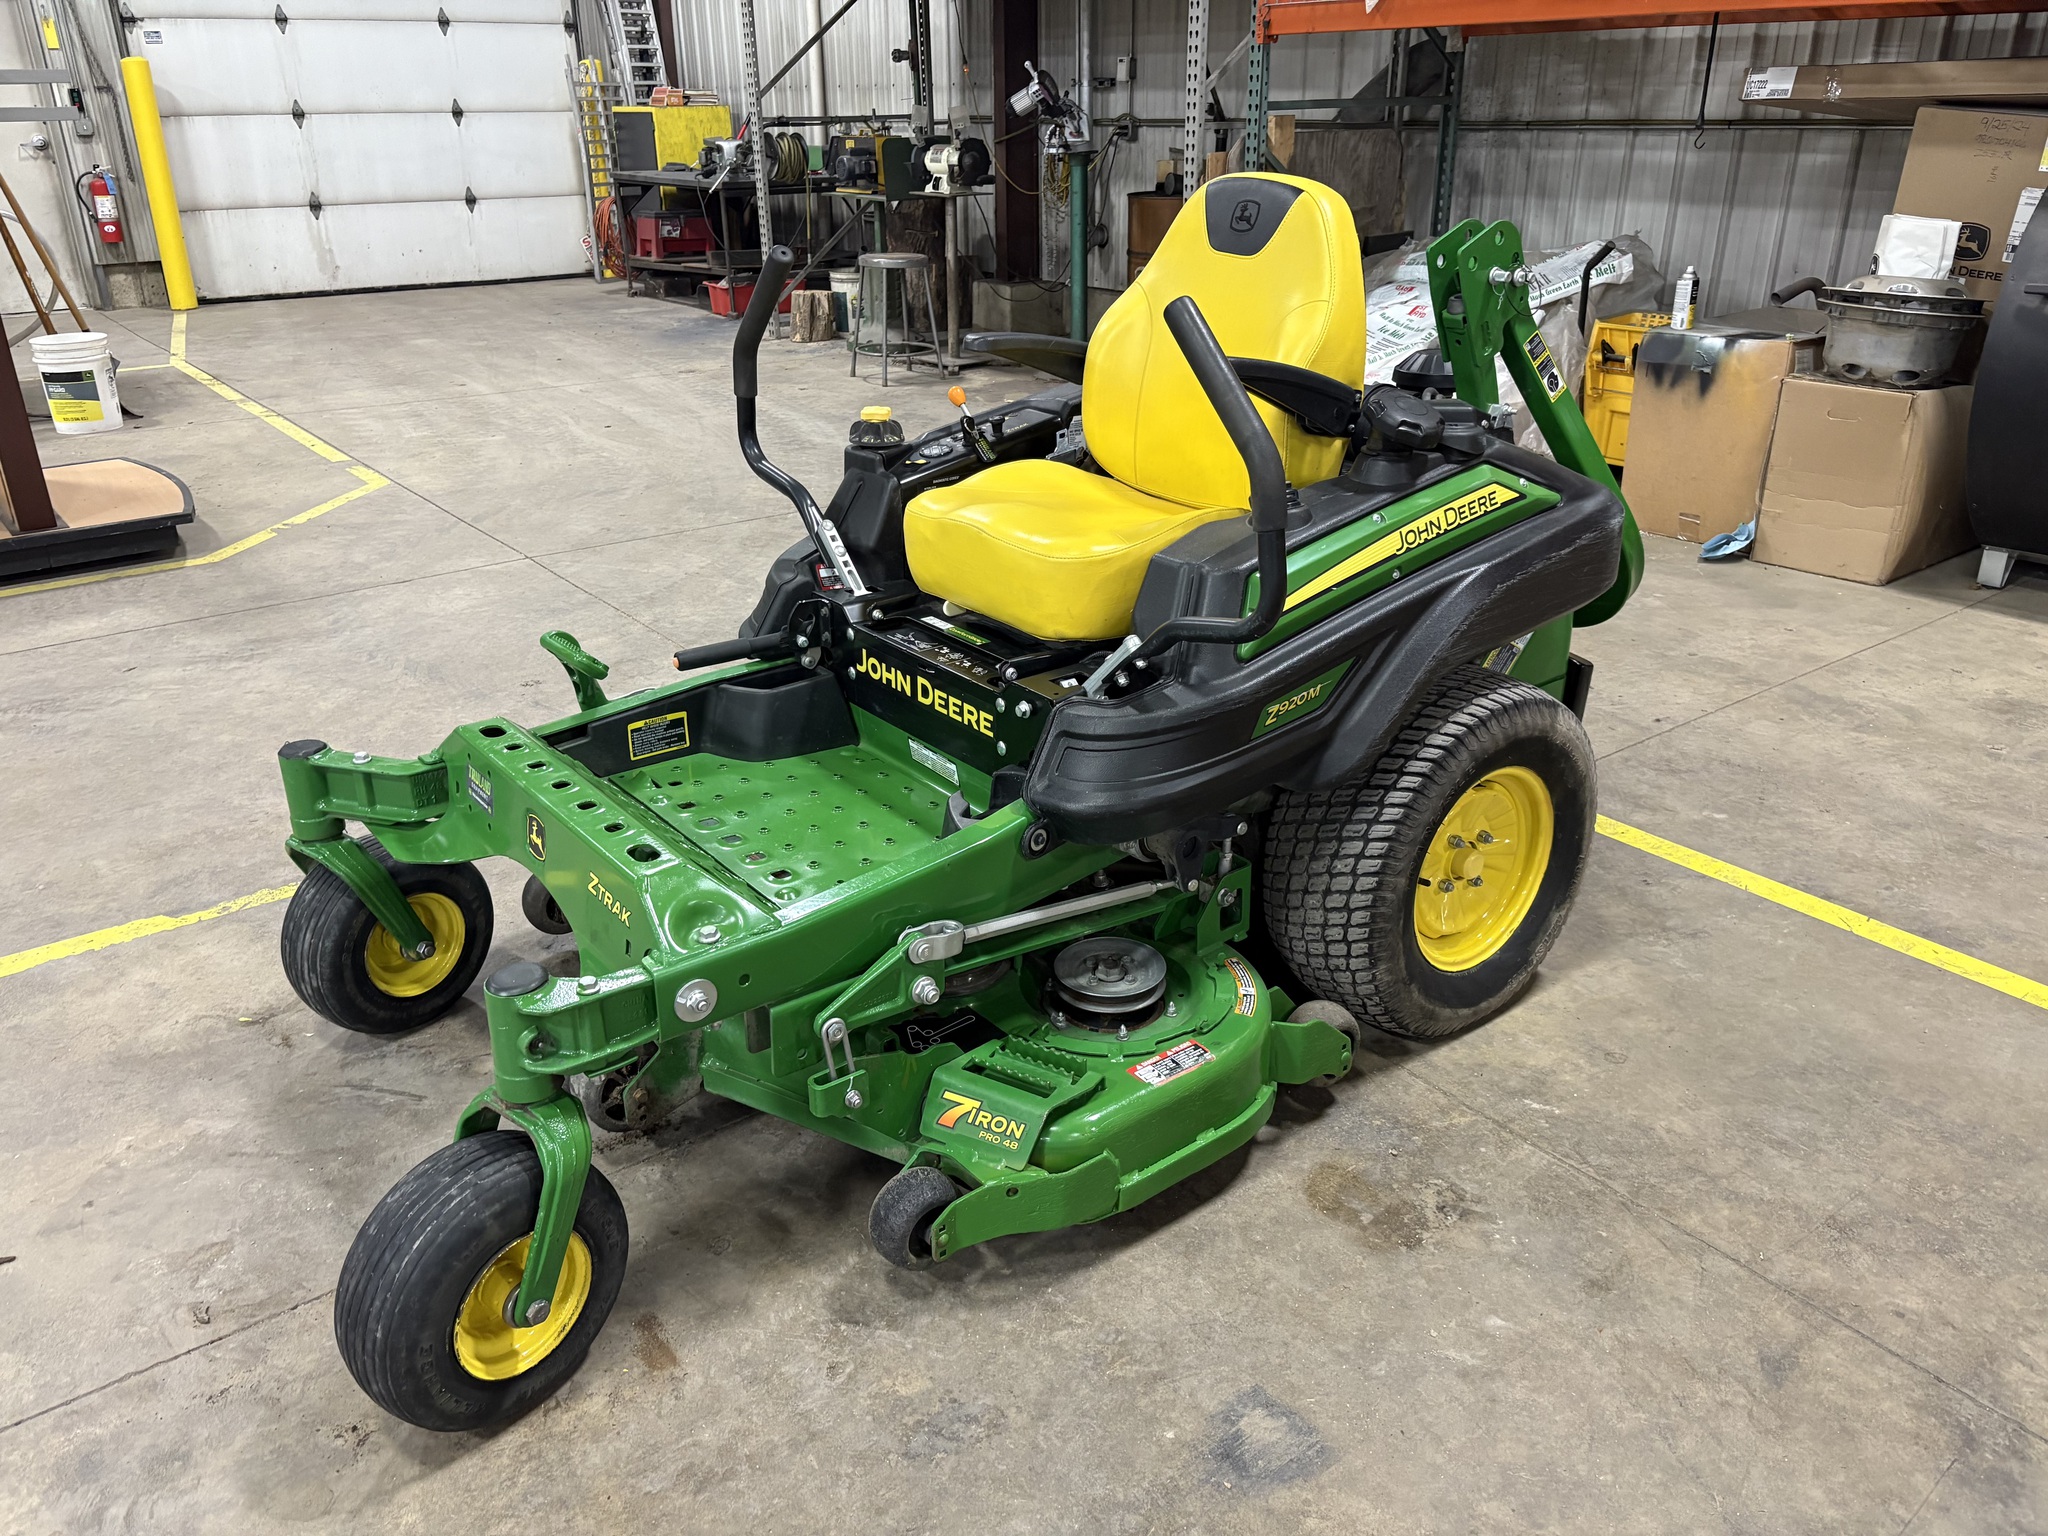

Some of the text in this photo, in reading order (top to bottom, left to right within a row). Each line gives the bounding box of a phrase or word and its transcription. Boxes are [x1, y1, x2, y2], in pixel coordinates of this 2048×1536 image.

[1595, 263, 1616, 278] Melt
[1958, 266, 2003, 282] DEERE
[1545, 284, 1563, 296] Green
[1562, 279, 1580, 291] Earth
[1395, 490, 1499, 553] JOHN DEERE
[856, 648, 994, 738] JOHN DEERE
[1264, 683, 1322, 727] Z920M
[587, 871, 632, 928] ZTRAK
[979, 1131, 1019, 1150] PRO 48
